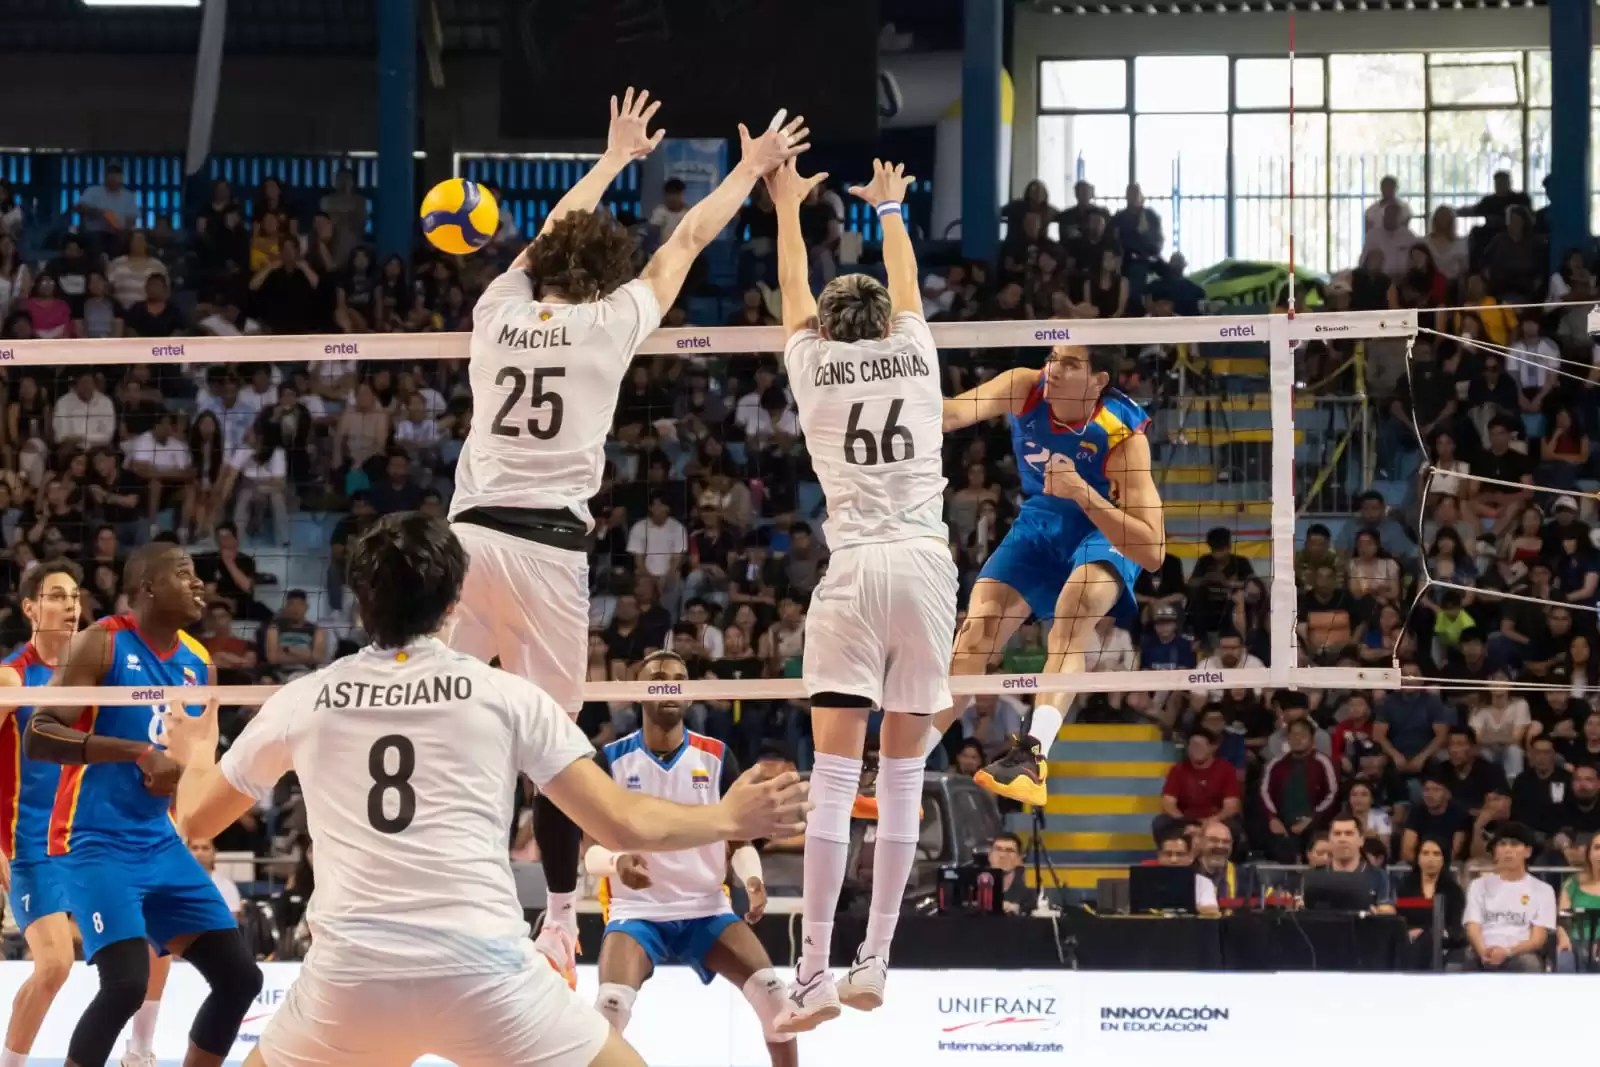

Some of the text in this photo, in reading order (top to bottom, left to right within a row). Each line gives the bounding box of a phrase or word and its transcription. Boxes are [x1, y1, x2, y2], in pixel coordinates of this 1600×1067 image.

[497, 324, 572, 349] MACIEL
[1034, 328, 1070, 341] entel
[1220, 324, 1255, 337] entel
[324, 343, 359, 355] entel
[676, 336, 711, 349] entel
[152, 344, 185, 357] entel
[815, 352, 930, 387] DENIS CABAÑAS
[491, 366, 566, 440] 25
[844, 398, 915, 466] 66
[1002, 676, 1038, 689] entel
[1188, 671, 1224, 683] entel
[131, 688, 165, 700] entel
[313, 676, 472, 712] ASTEGIANO
[647, 683, 682, 695] entel
[367, 734, 416, 834] 8
[92, 911, 104, 933] 8
[938, 997, 1056, 1014] UNIFRANZ
[1100, 1004, 1229, 1020] INNOVACIÓN
[1100, 1021, 1208, 1032] EN EDUCACIÓN
[938, 1040, 1064, 1052] Internacionalizate
